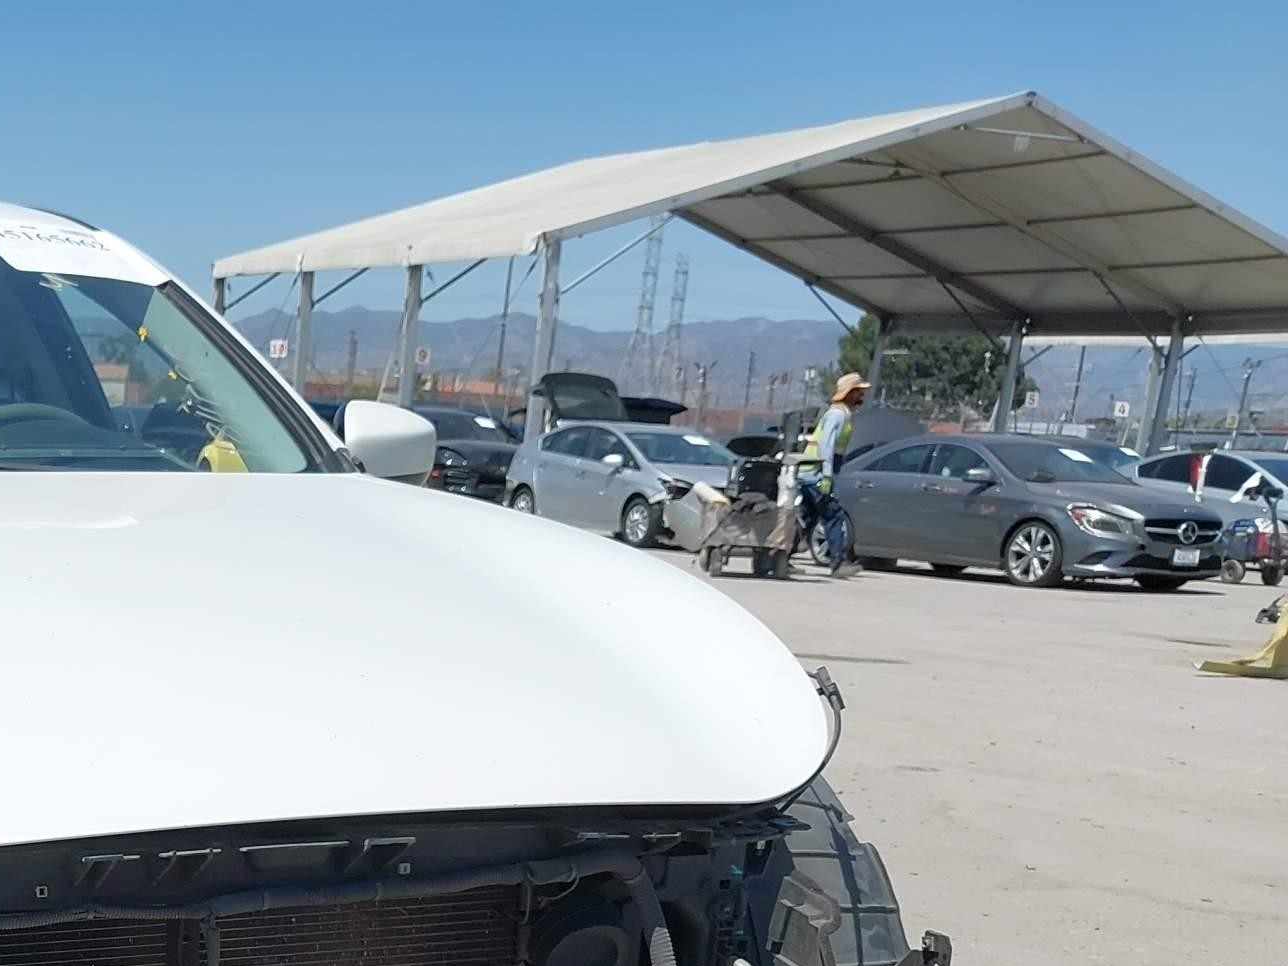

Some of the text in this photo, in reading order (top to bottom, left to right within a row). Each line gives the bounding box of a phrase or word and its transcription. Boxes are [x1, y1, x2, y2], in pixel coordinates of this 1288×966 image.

[272, 344, 285, 355] 10
[418, 350, 427, 362] 9
[1118, 404, 1126, 415] 4
